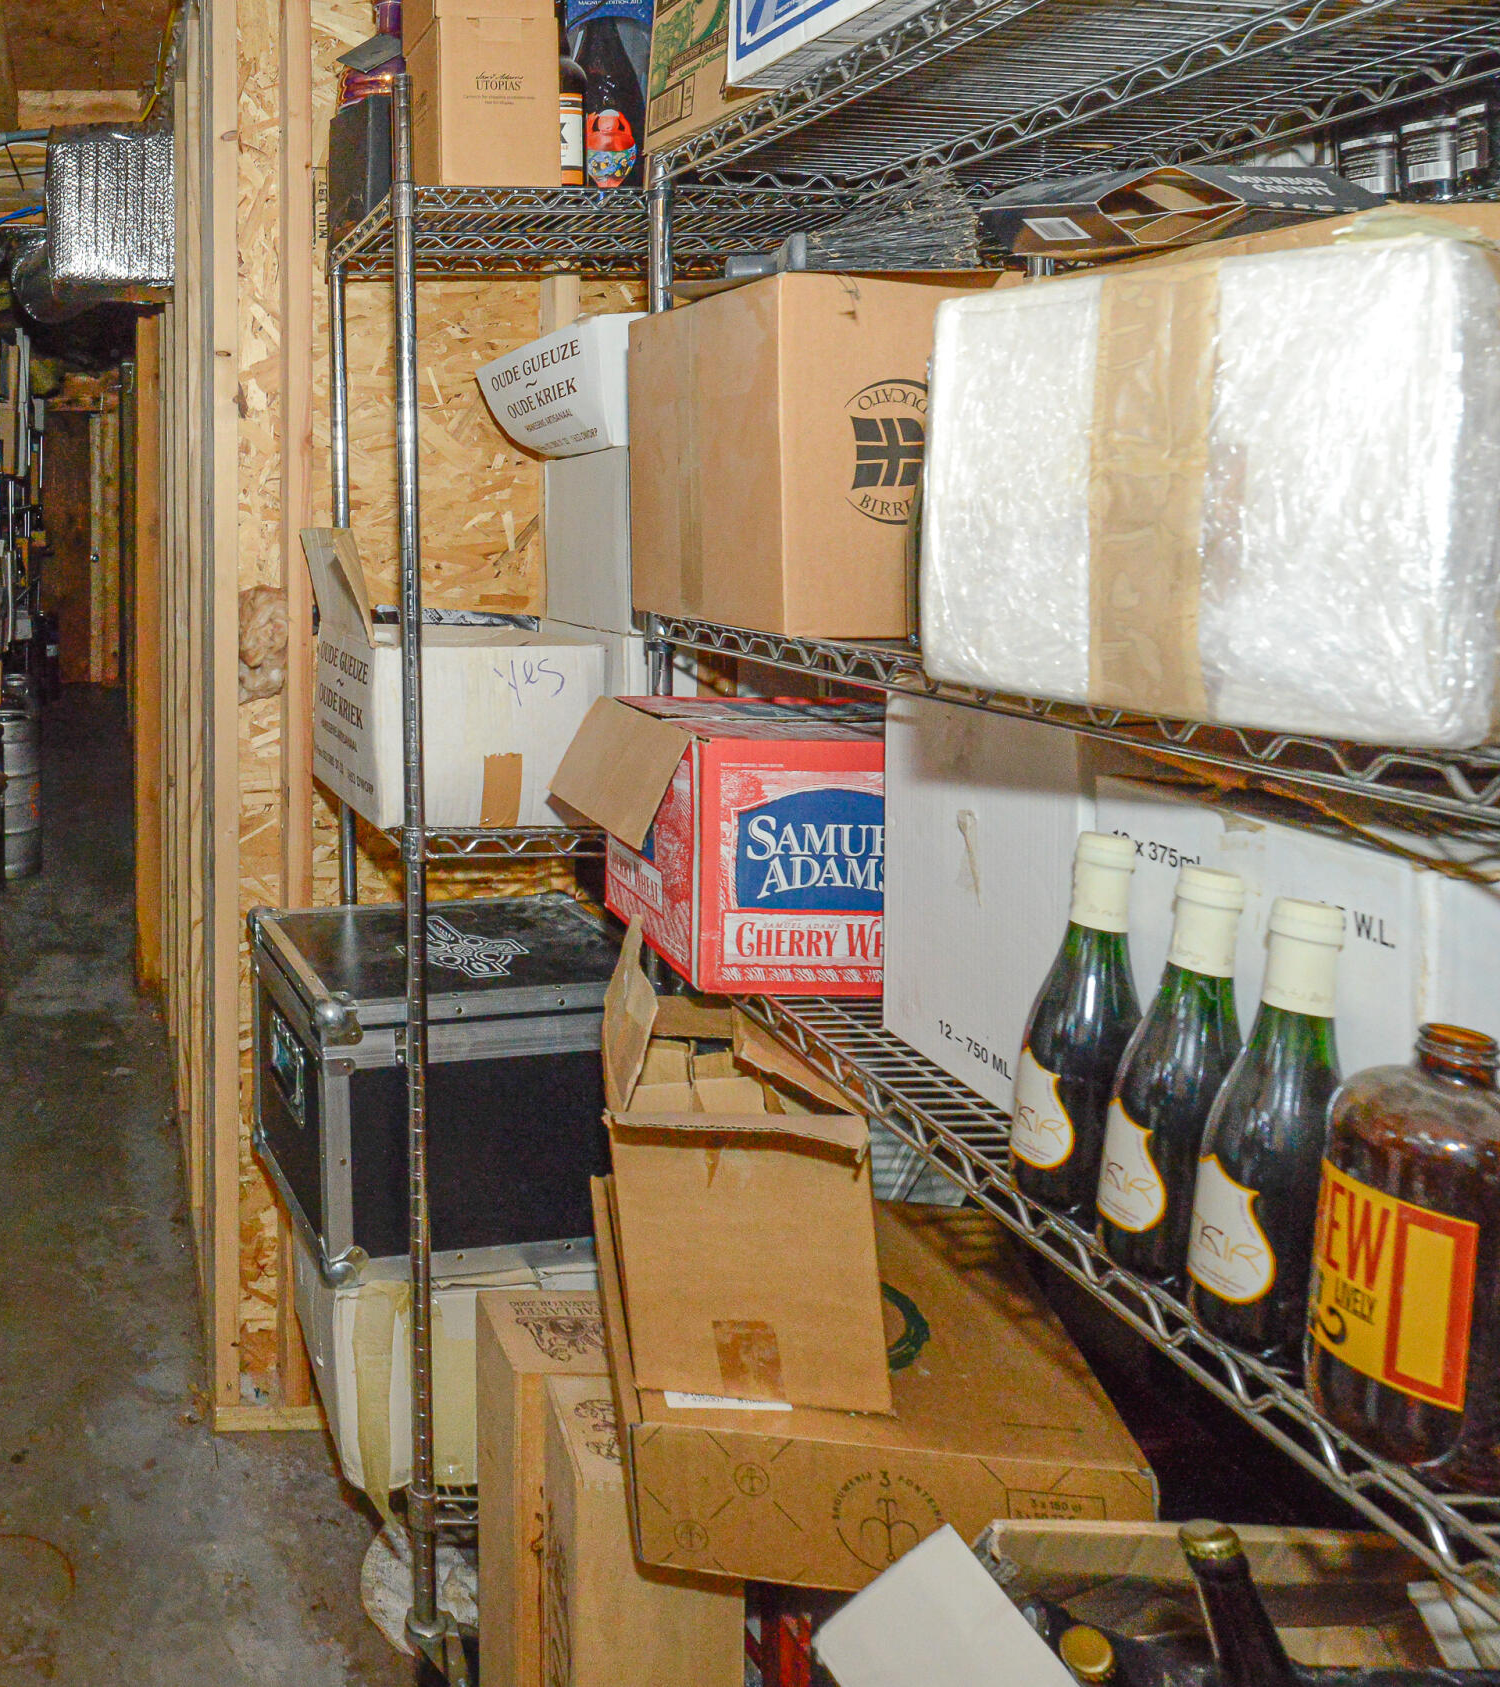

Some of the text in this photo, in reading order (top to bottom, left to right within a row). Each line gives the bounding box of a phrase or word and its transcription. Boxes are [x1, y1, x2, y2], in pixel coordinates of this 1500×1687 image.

[476, 80, 521, 91] UTOPIAS
[1228, 175, 1327, 186] BOURBON
[1252, 184, 1337, 196] COUNTY
[491, 339, 580, 391] OUDE GUEUZE
[507, 377, 577, 419] OUDE KRIEK
[320, 641, 369, 685] OUDE GUEUZE
[319, 682, 363, 730] OUDE KRIEK
[736, 921, 839, 958] CHERRY
[762, 921, 841, 930] SAMUEL ADAMS
[1354, 911, 1395, 949] W.L.
[992, 1053, 1012, 1081] ML
[1325, 1180, 1390, 1291] EW
[879, 1470, 891, 1487] 3
[898, 1475, 945, 1522] FONTEINE
